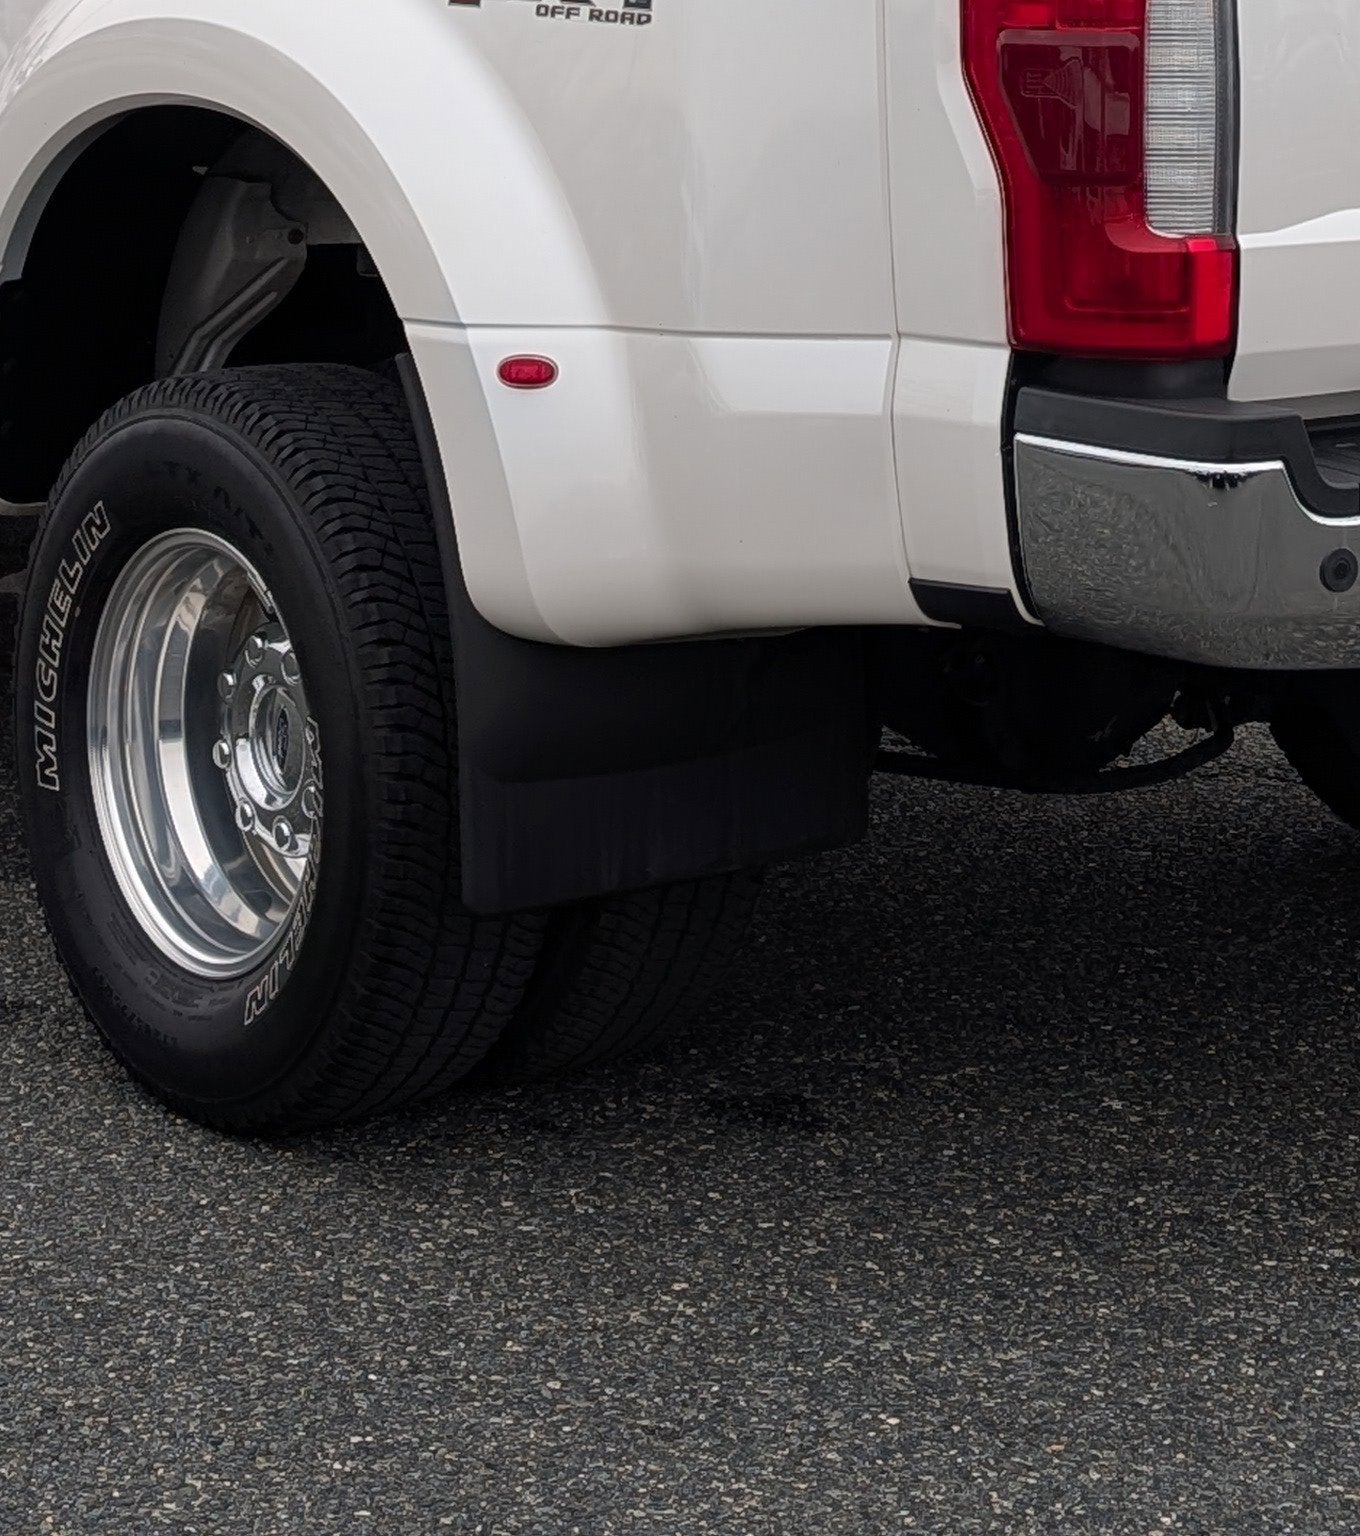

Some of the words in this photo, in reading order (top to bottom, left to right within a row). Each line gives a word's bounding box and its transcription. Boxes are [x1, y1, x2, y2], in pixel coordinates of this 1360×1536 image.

[535, 4, 581, 20] OFF
[589, 7, 652, 25] ROAD
[34, 500, 111, 792] MICHELIN
